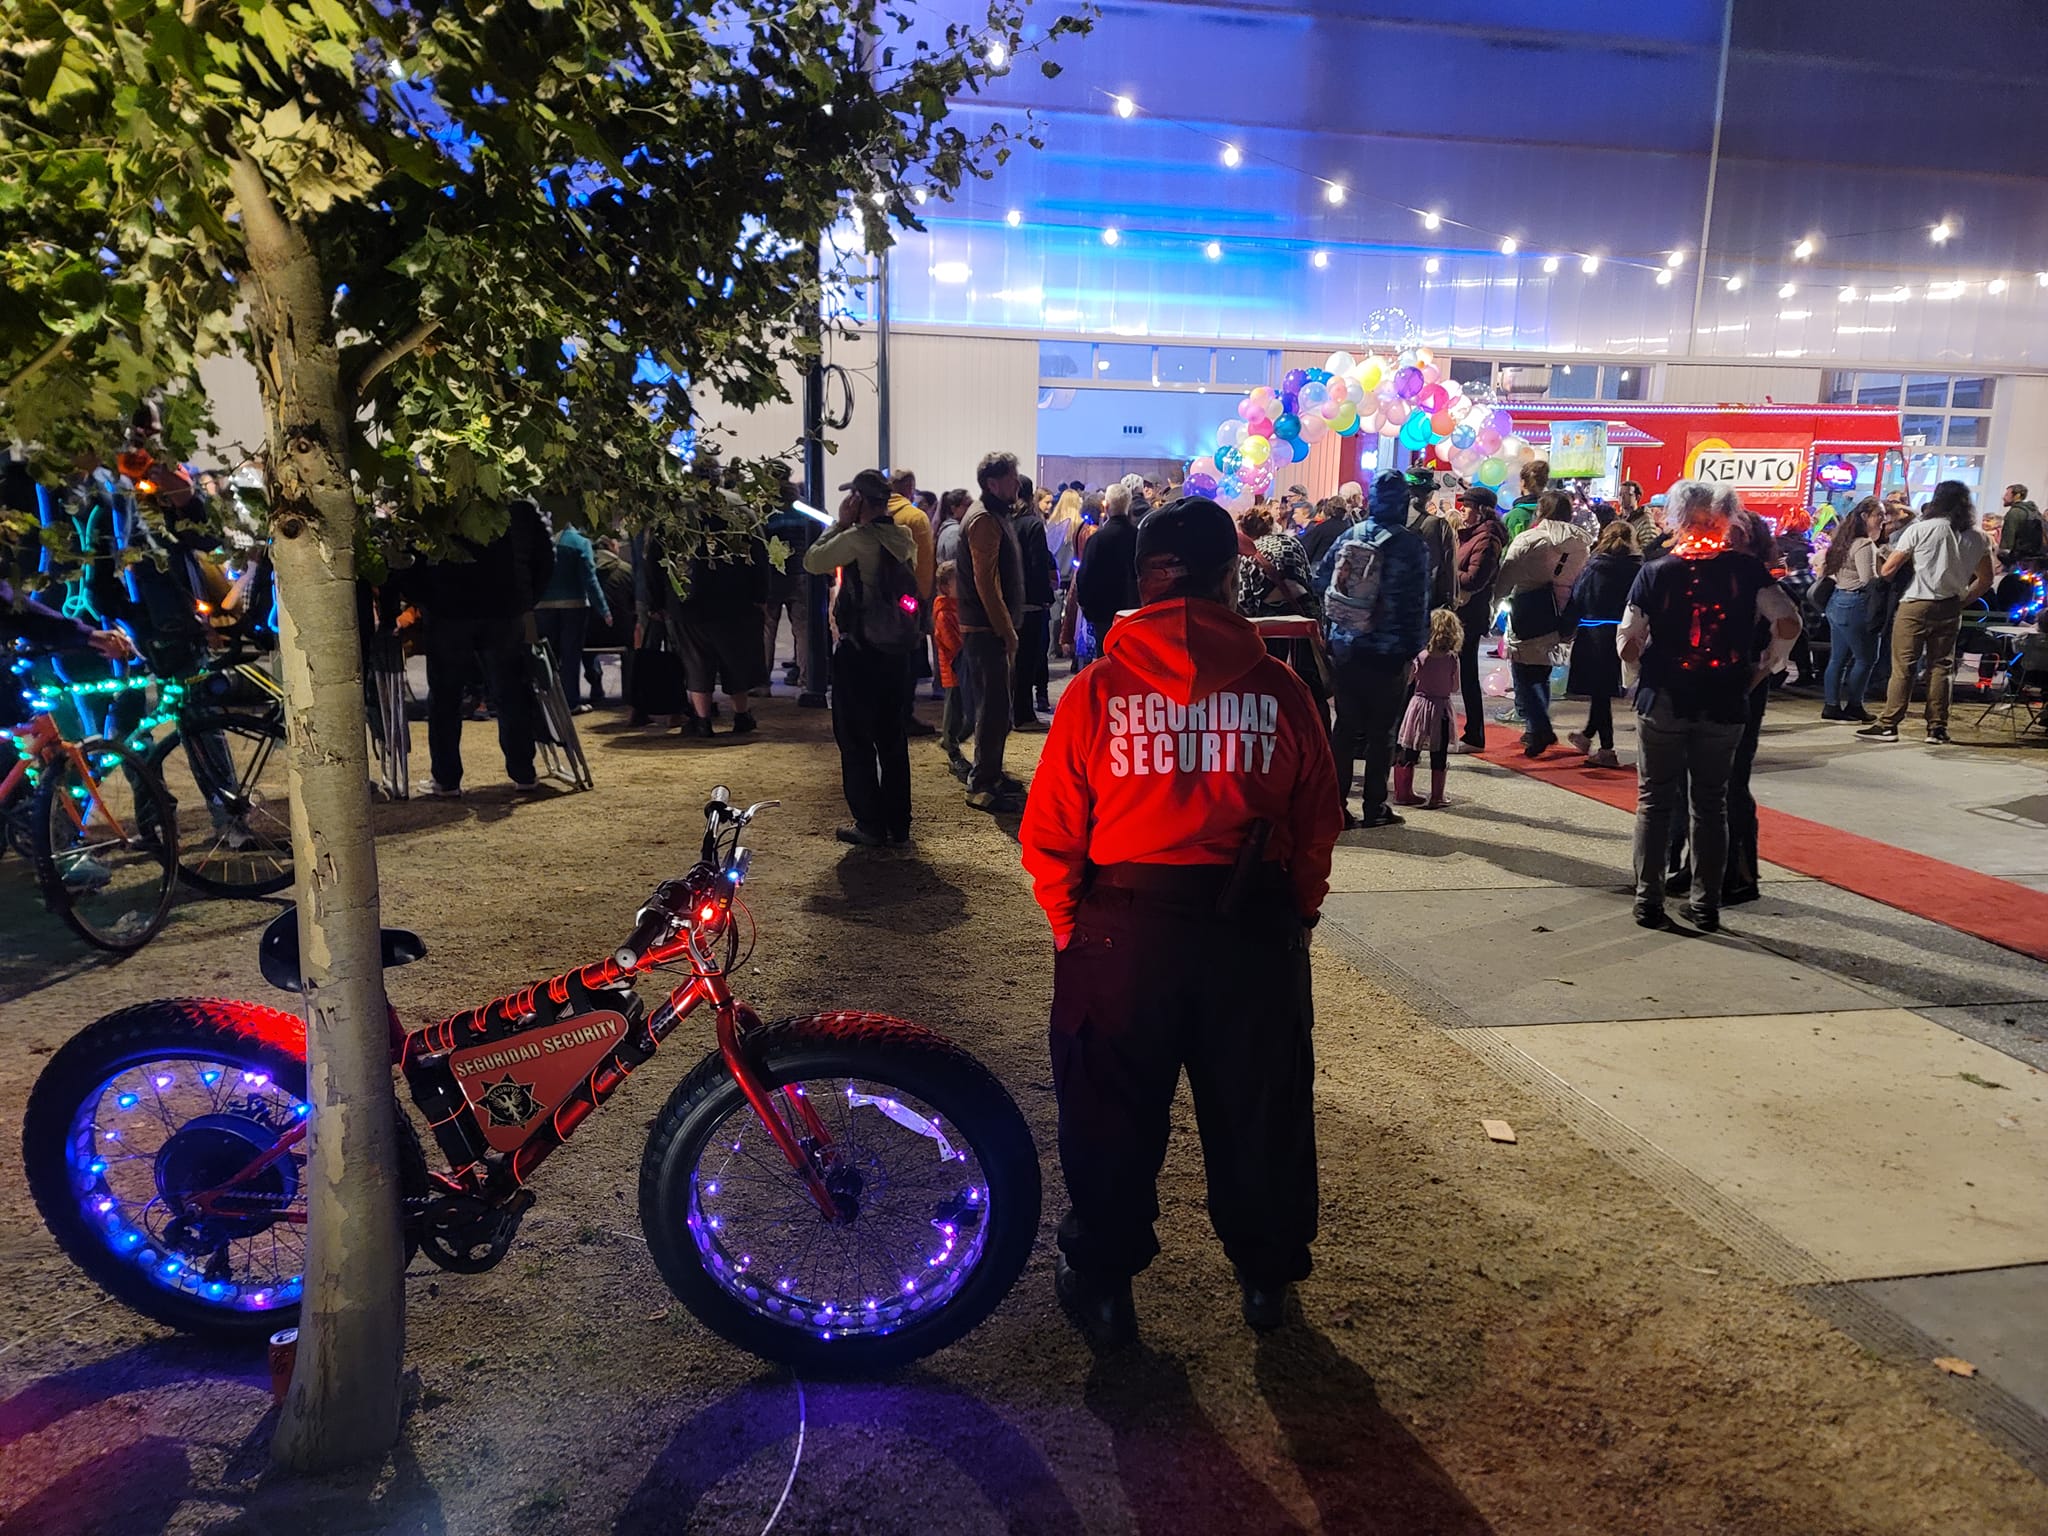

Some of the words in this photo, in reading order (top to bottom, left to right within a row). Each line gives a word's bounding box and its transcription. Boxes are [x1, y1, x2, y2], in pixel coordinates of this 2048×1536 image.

[1698, 458, 1794, 482] KENTO
[1107, 692, 1279, 736] SEGURIDAD
[1109, 733, 1277, 777] SECURITY
[455, 1044, 541, 1078] SEGURIDAD
[542, 1019, 619, 1054] SECURITY
